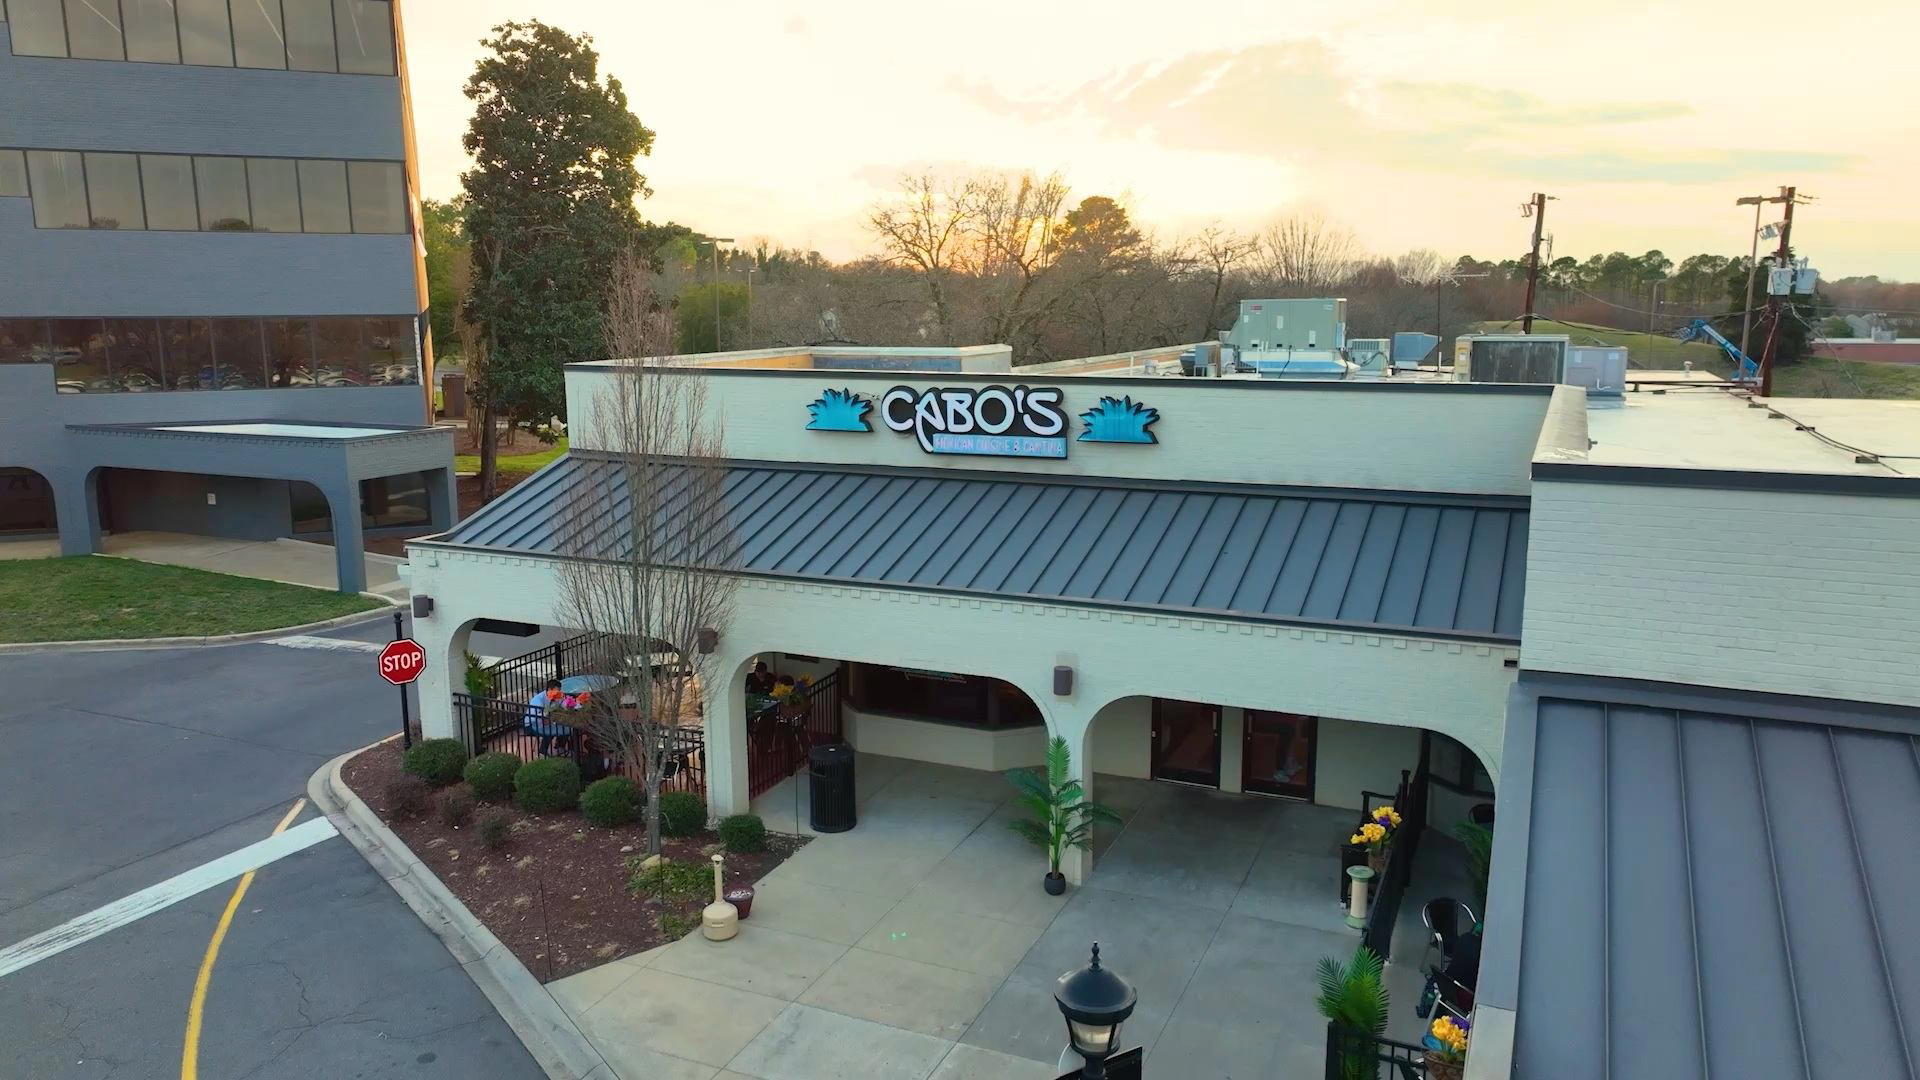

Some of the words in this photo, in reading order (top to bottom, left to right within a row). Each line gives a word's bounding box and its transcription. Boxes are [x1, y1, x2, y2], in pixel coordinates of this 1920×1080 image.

[882, 389, 1063, 453] CABO'S
[1013, 440, 1020, 453] &
[383, 651, 421, 672] STOP
